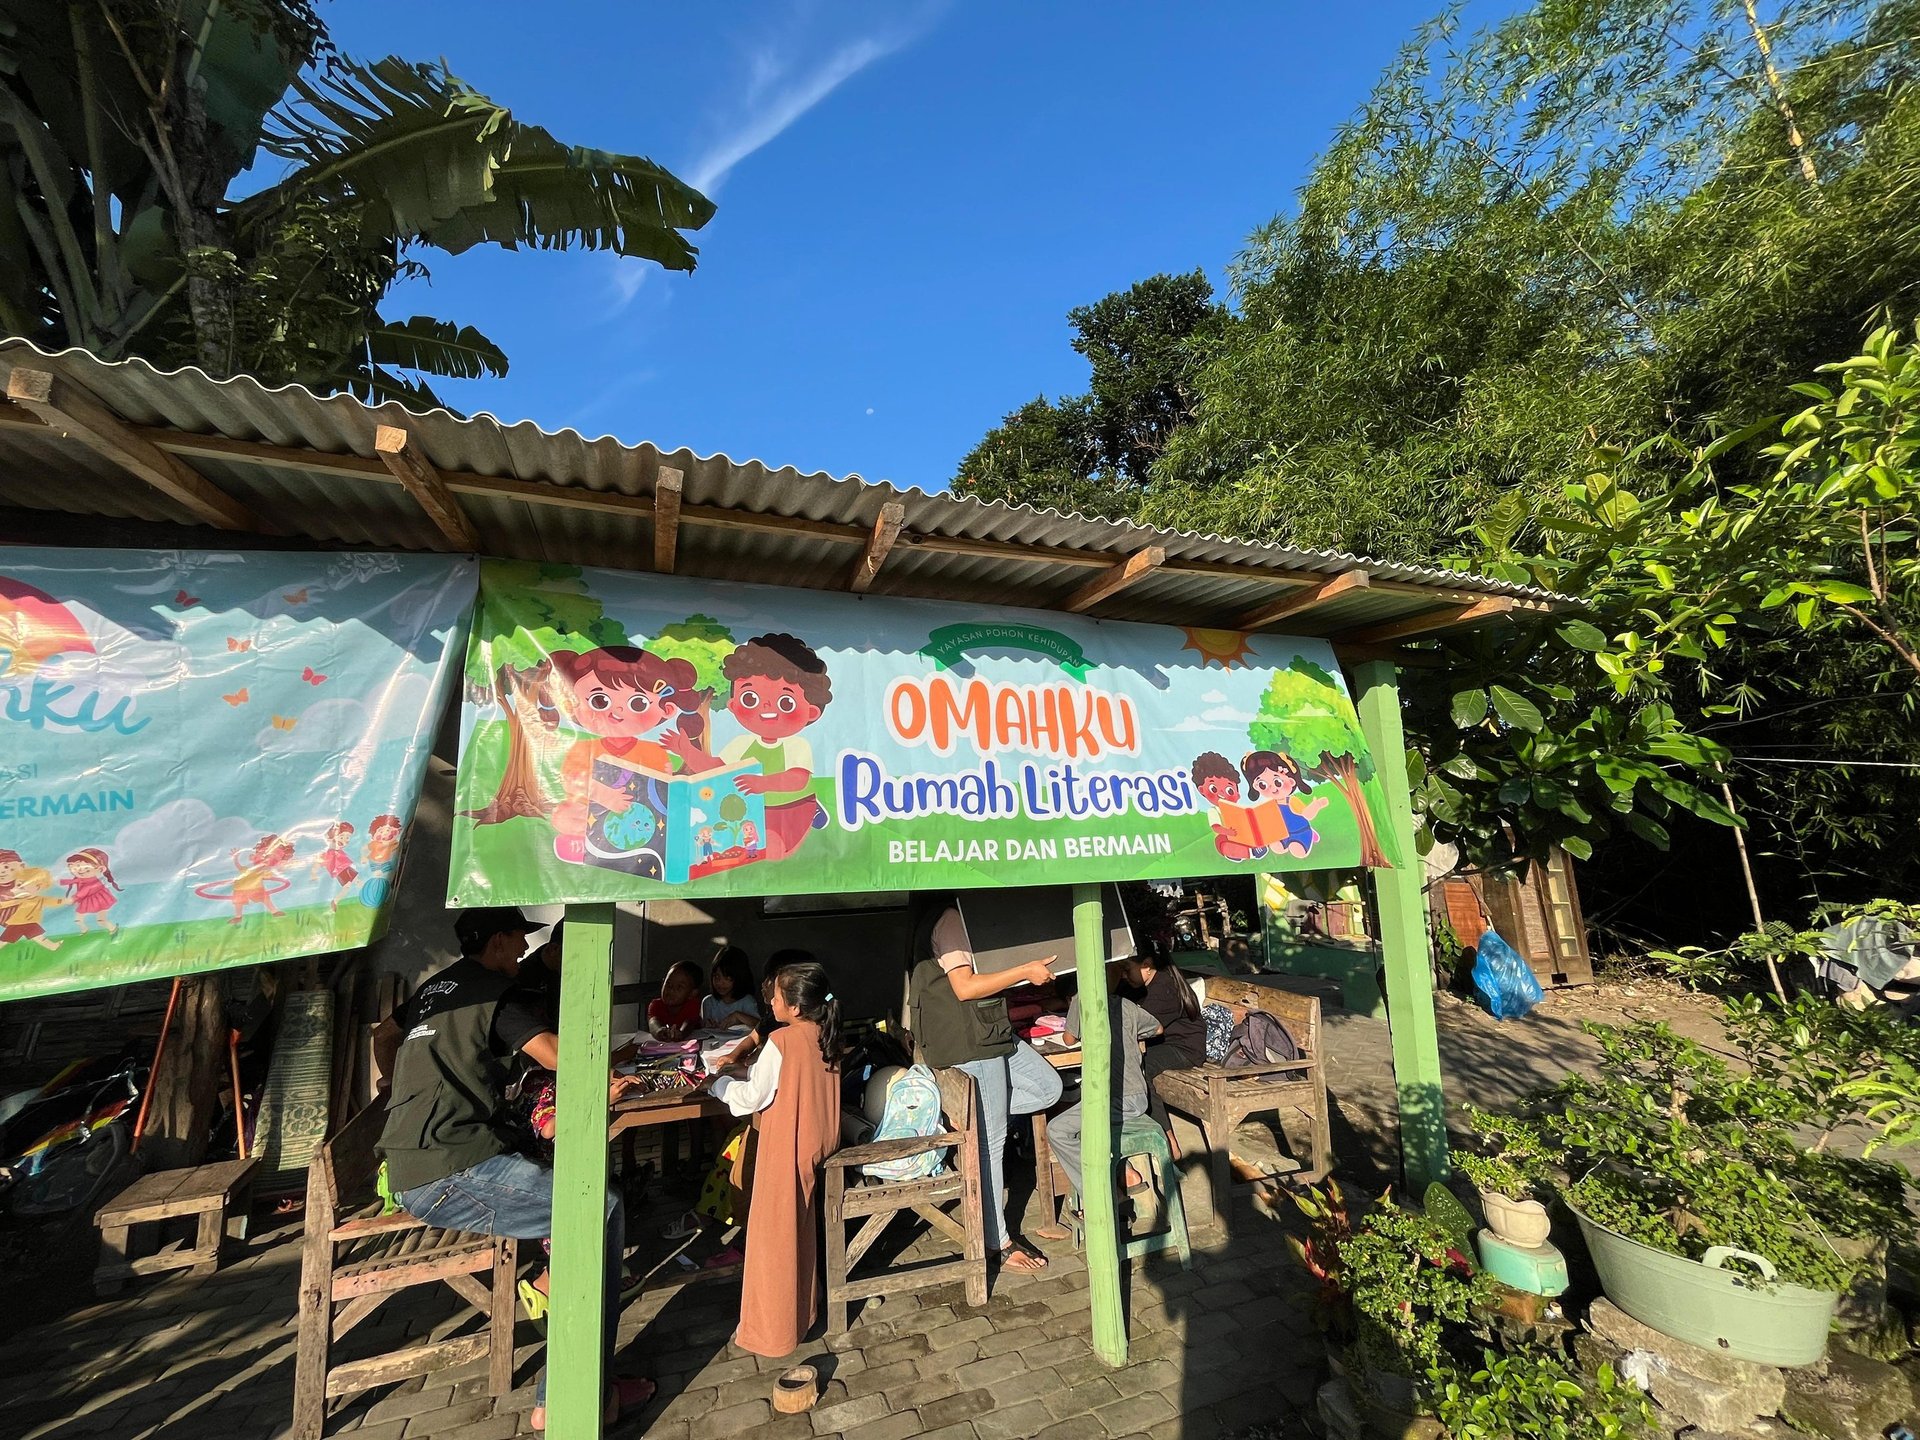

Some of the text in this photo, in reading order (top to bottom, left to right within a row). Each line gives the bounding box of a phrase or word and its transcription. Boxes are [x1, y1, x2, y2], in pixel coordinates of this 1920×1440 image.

[936, 628, 1081, 667] YAYASAN POHON KEHIDUPAN
[891, 678, 1135, 758] OMAHKU
[842, 754, 1193, 824] Rumah Literasi
[889, 833, 1172, 864] BELAJAR DAN BERMAIN
